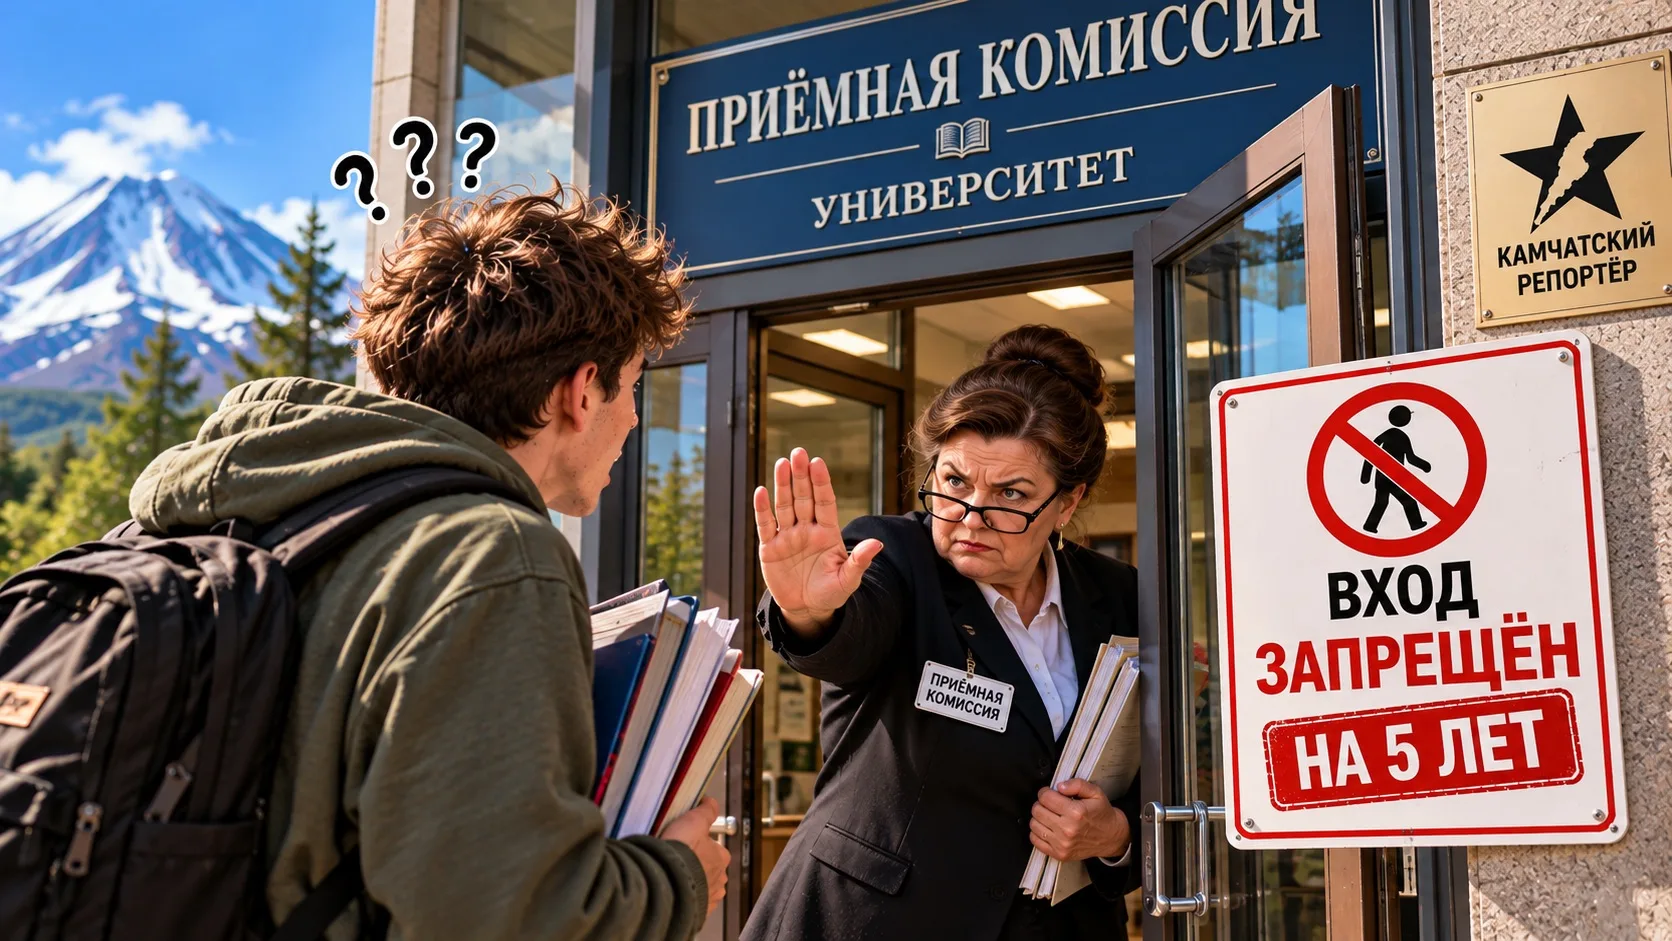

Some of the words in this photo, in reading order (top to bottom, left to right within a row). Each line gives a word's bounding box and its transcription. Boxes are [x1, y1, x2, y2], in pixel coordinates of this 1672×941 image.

[686, 49, 961, 154] ПРИЁМНАЯ
[977, 0, 1321, 100] КОМИССИЯ
[811, 146, 1134, 229] УНИВЕРСИТЕТ
[1497, 221, 1655, 268] КАМЧАТСКИЙ
[1517, 256, 1637, 296] РЕПОРТЁР
[1327, 560, 1480, 621] ВХОД
[1256, 611, 1580, 695] ЗАПРЕЩЁН
[926, 689, 1000, 721] КОМИССИЯ
[930, 672, 1004, 705] ПРИЁМНАЯ
[1294, 734, 1371, 791] НА
[1385, 723, 1421, 781] 5
[1438, 709, 1544, 777] ЛЕТ
